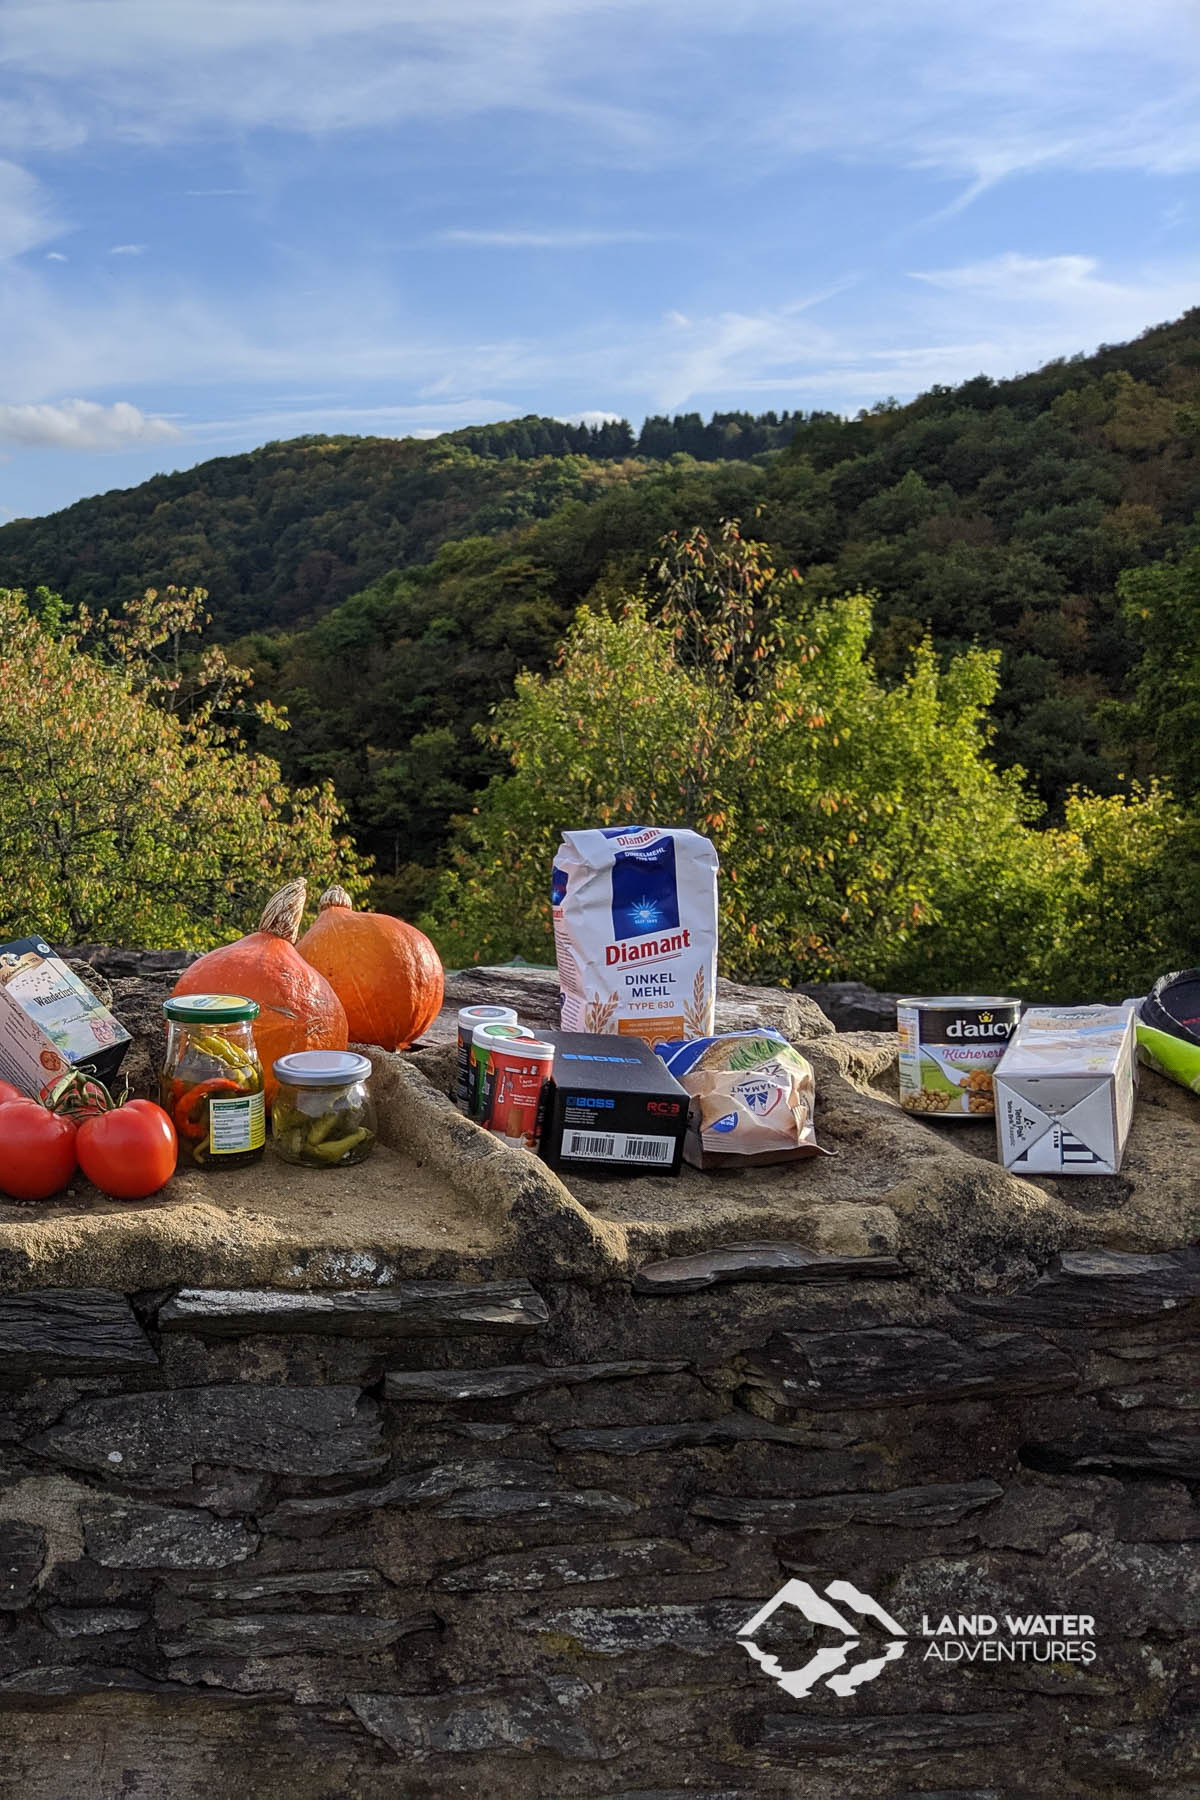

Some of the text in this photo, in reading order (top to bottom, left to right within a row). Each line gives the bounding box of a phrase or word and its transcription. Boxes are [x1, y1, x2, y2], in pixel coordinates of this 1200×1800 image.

[616, 829, 661, 847] Diamant
[605, 929, 691, 966] Diamant
[625, 973, 677, 986] DINKEL
[632, 986, 671, 998] MEHL
[628, 1000, 675, 1011] TYPE 630
[946, 1020, 1013, 1038] d'aucy
[576, 1097, 615, 1109] BOSS
[647, 1101, 680, 1113] RC-3
[1015, 1108, 1023, 1125] Tetra
